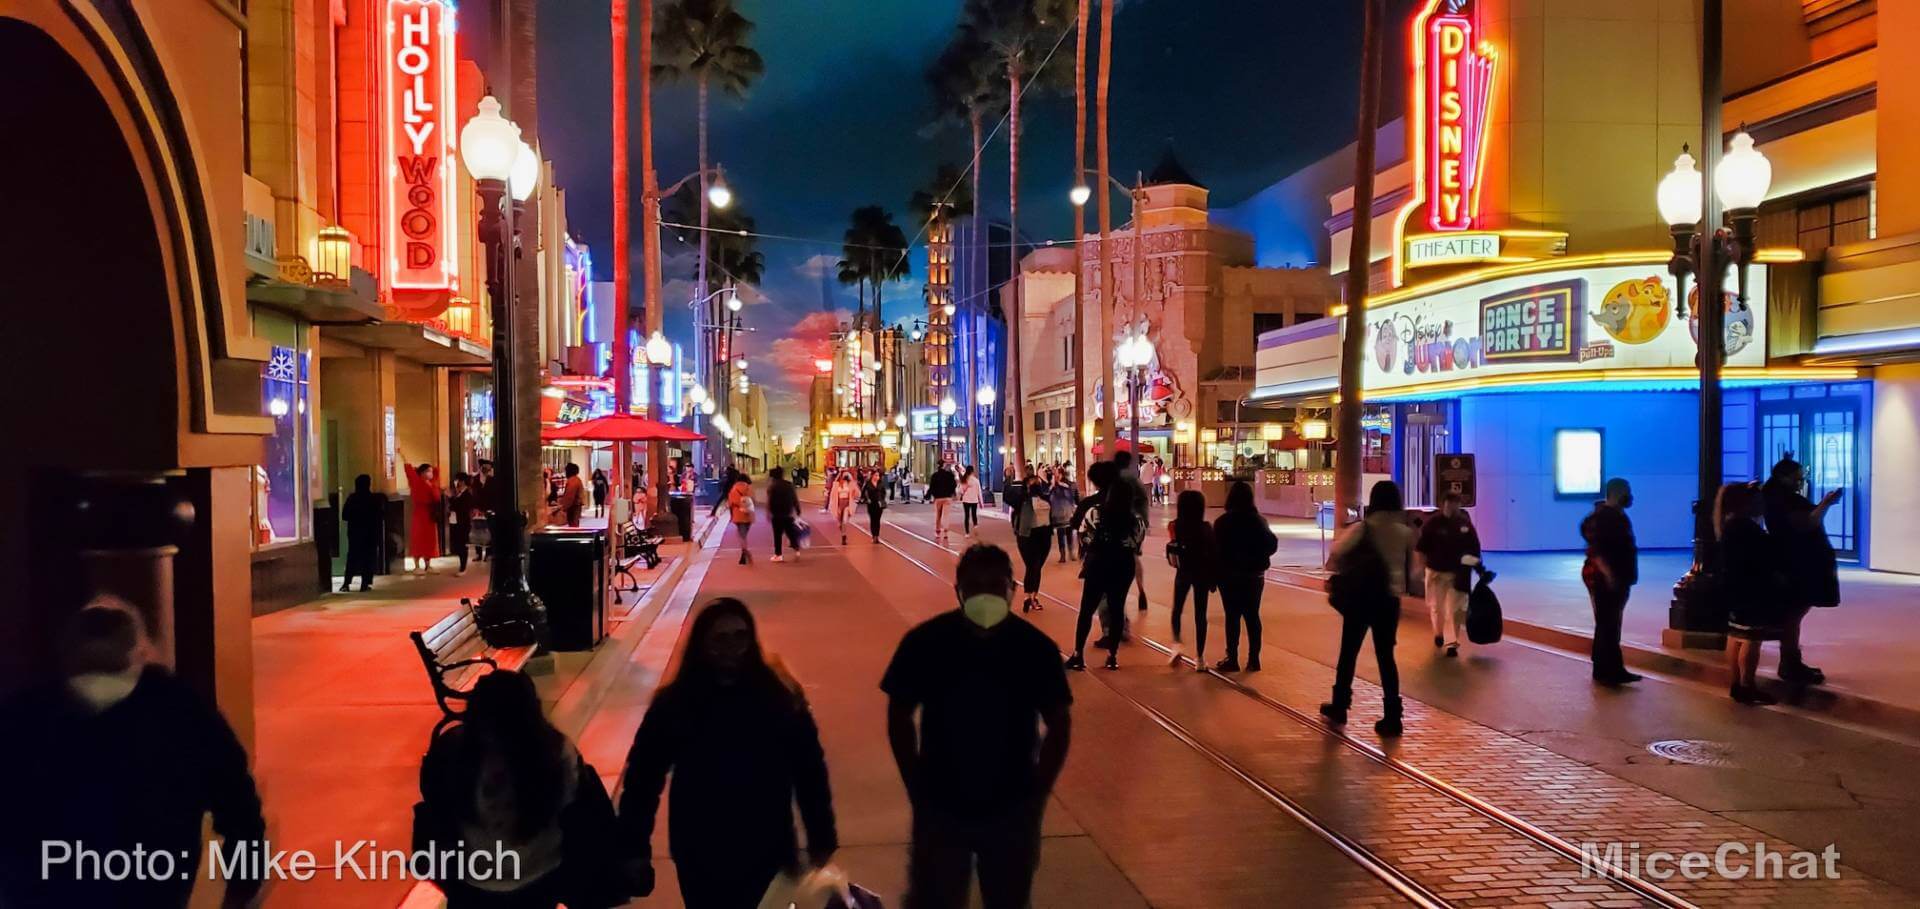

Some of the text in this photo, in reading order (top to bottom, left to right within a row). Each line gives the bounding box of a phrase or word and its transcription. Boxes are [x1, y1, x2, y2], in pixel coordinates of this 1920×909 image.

[1440, 26, 1464, 221] DISNEY
[1414, 239, 1492, 258] THEATER
[1486, 298, 1555, 331] DANCE
[1486, 323, 1563, 352] PARTY!
